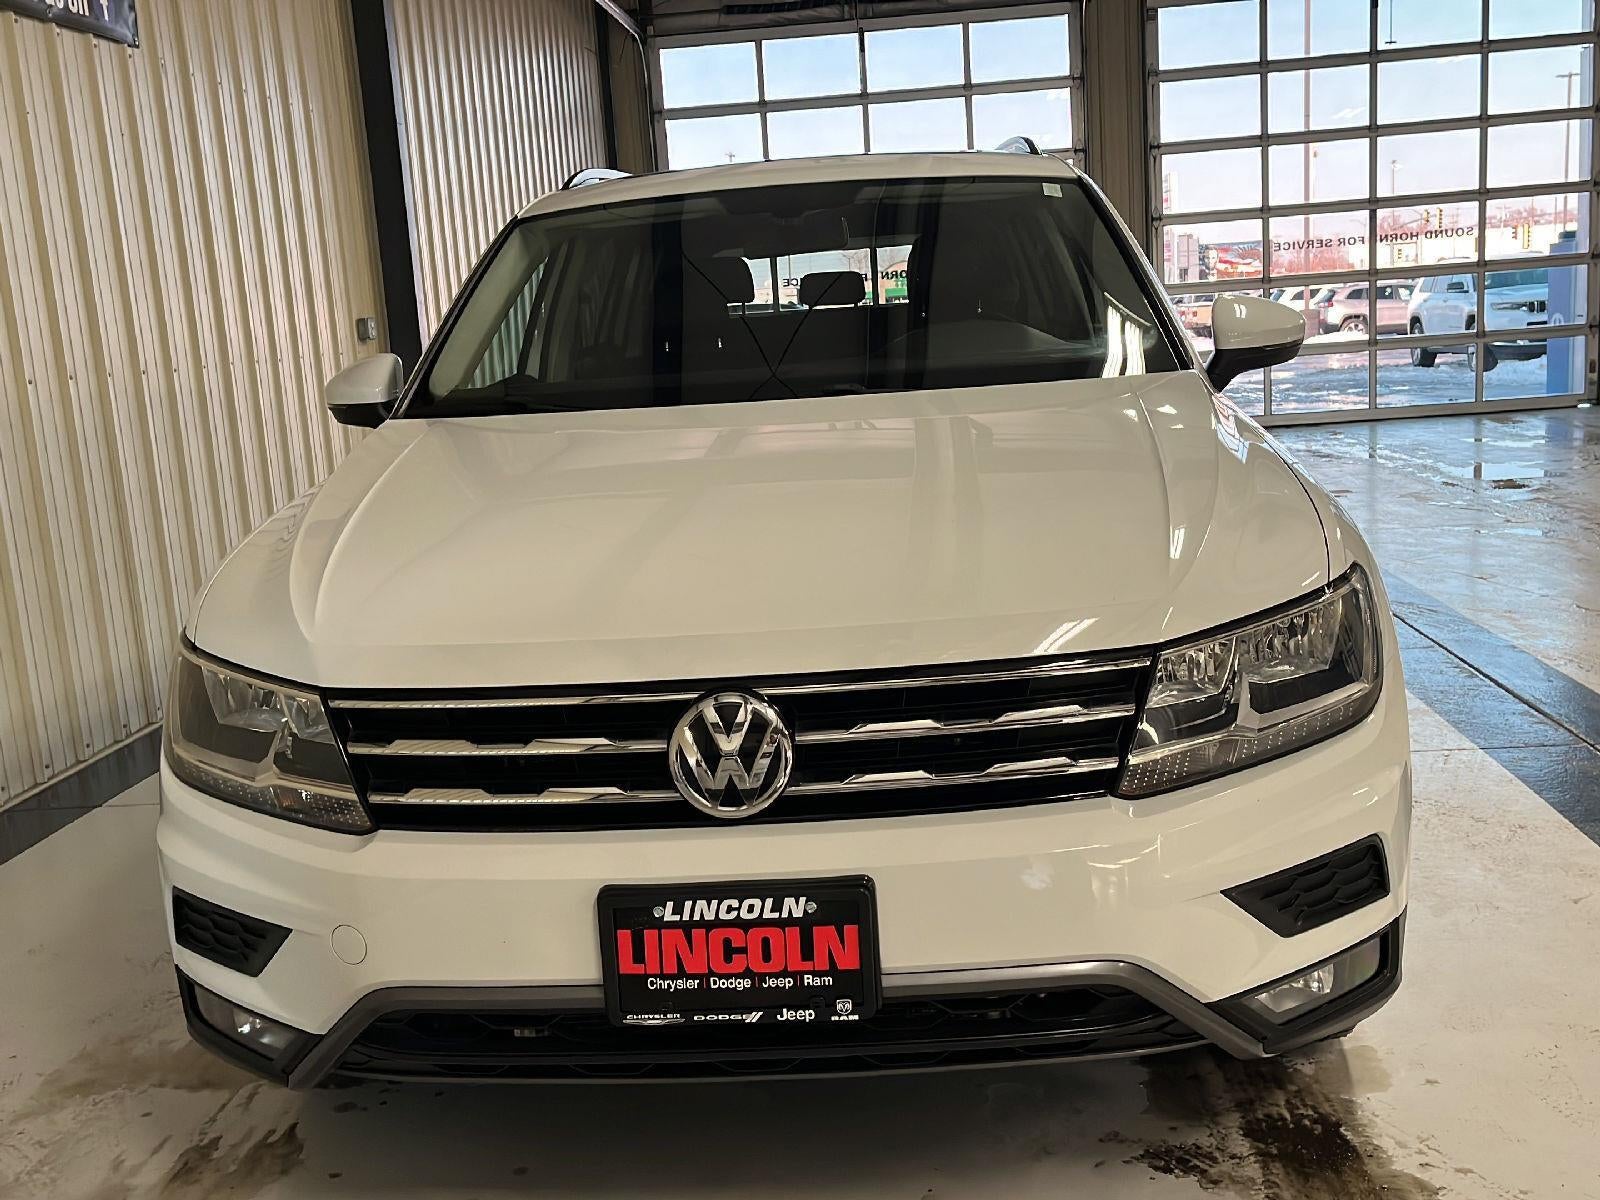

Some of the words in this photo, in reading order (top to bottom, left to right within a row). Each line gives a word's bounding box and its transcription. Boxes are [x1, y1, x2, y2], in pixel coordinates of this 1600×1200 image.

[663, 897, 807, 922] LINCOLN
[616, 924, 861, 975] LINCOLN
[647, 977, 700, 992] Chrysler
[710, 977, 752, 991] Dodge
[762, 976, 794, 990] Jeep
[803, 975, 833, 986] Ram
[693, 1013, 753, 1021] DODGE
[776, 1008, 816, 1022] Jeep
